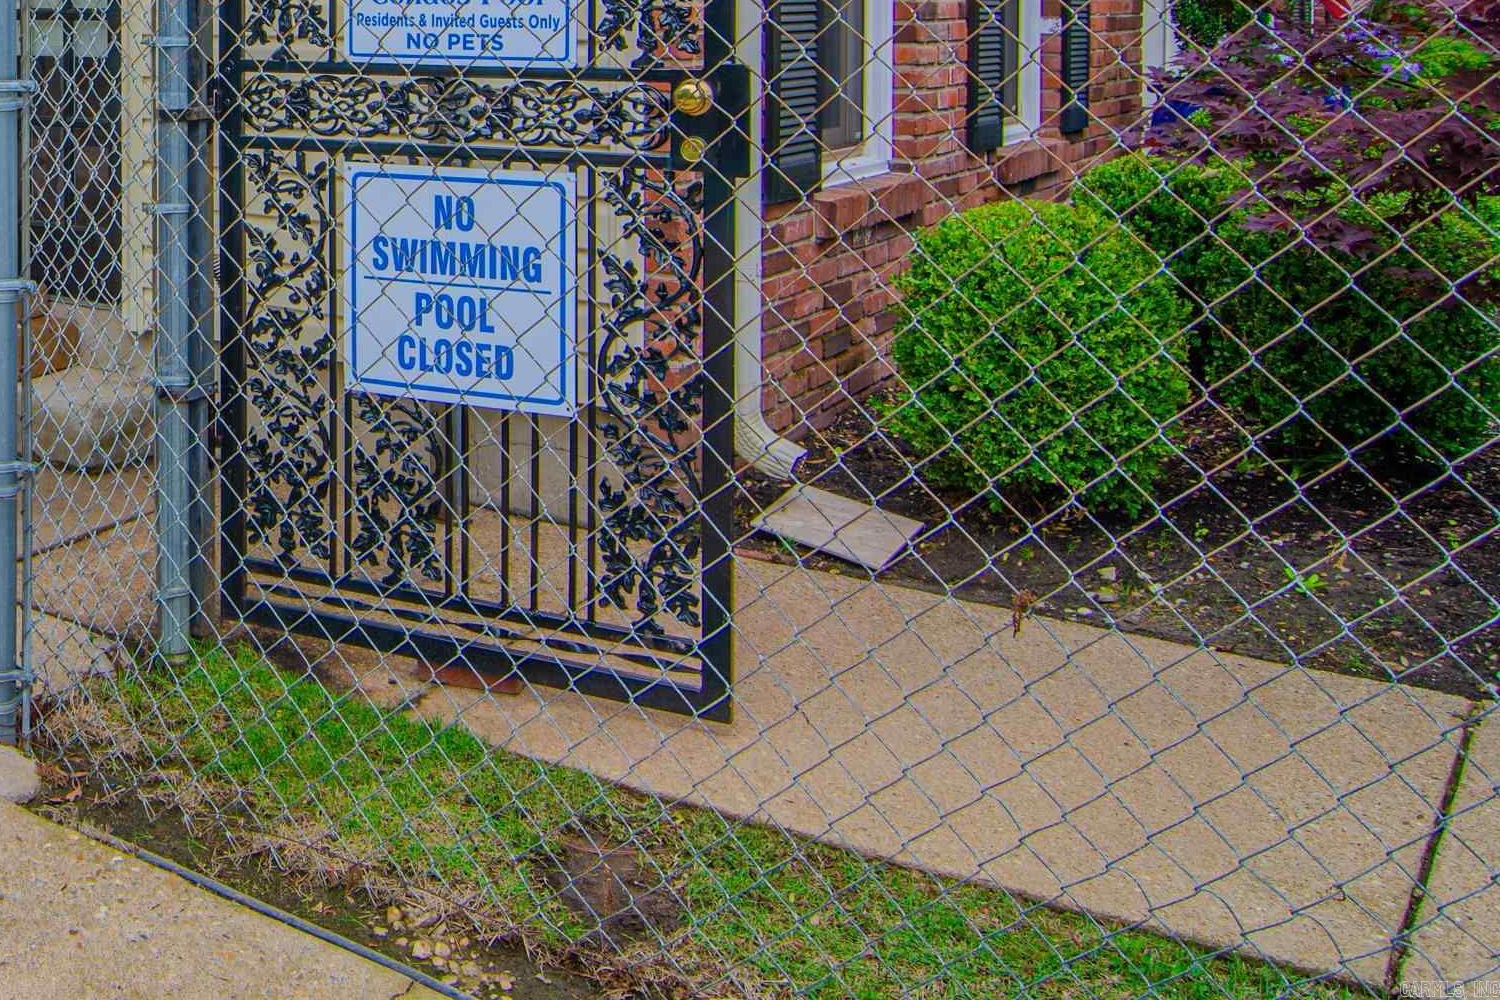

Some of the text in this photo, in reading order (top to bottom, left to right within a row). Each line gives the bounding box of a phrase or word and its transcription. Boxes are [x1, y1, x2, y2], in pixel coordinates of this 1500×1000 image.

[356, 12, 561, 32] Residents & Invited Guests Only
[406, 32, 504, 51] NO PETS
[434, 194, 476, 232] NO
[372, 235, 543, 284] SWIMMING
[414, 292, 496, 334] POOL
[396, 335, 515, 381] CLOSED
